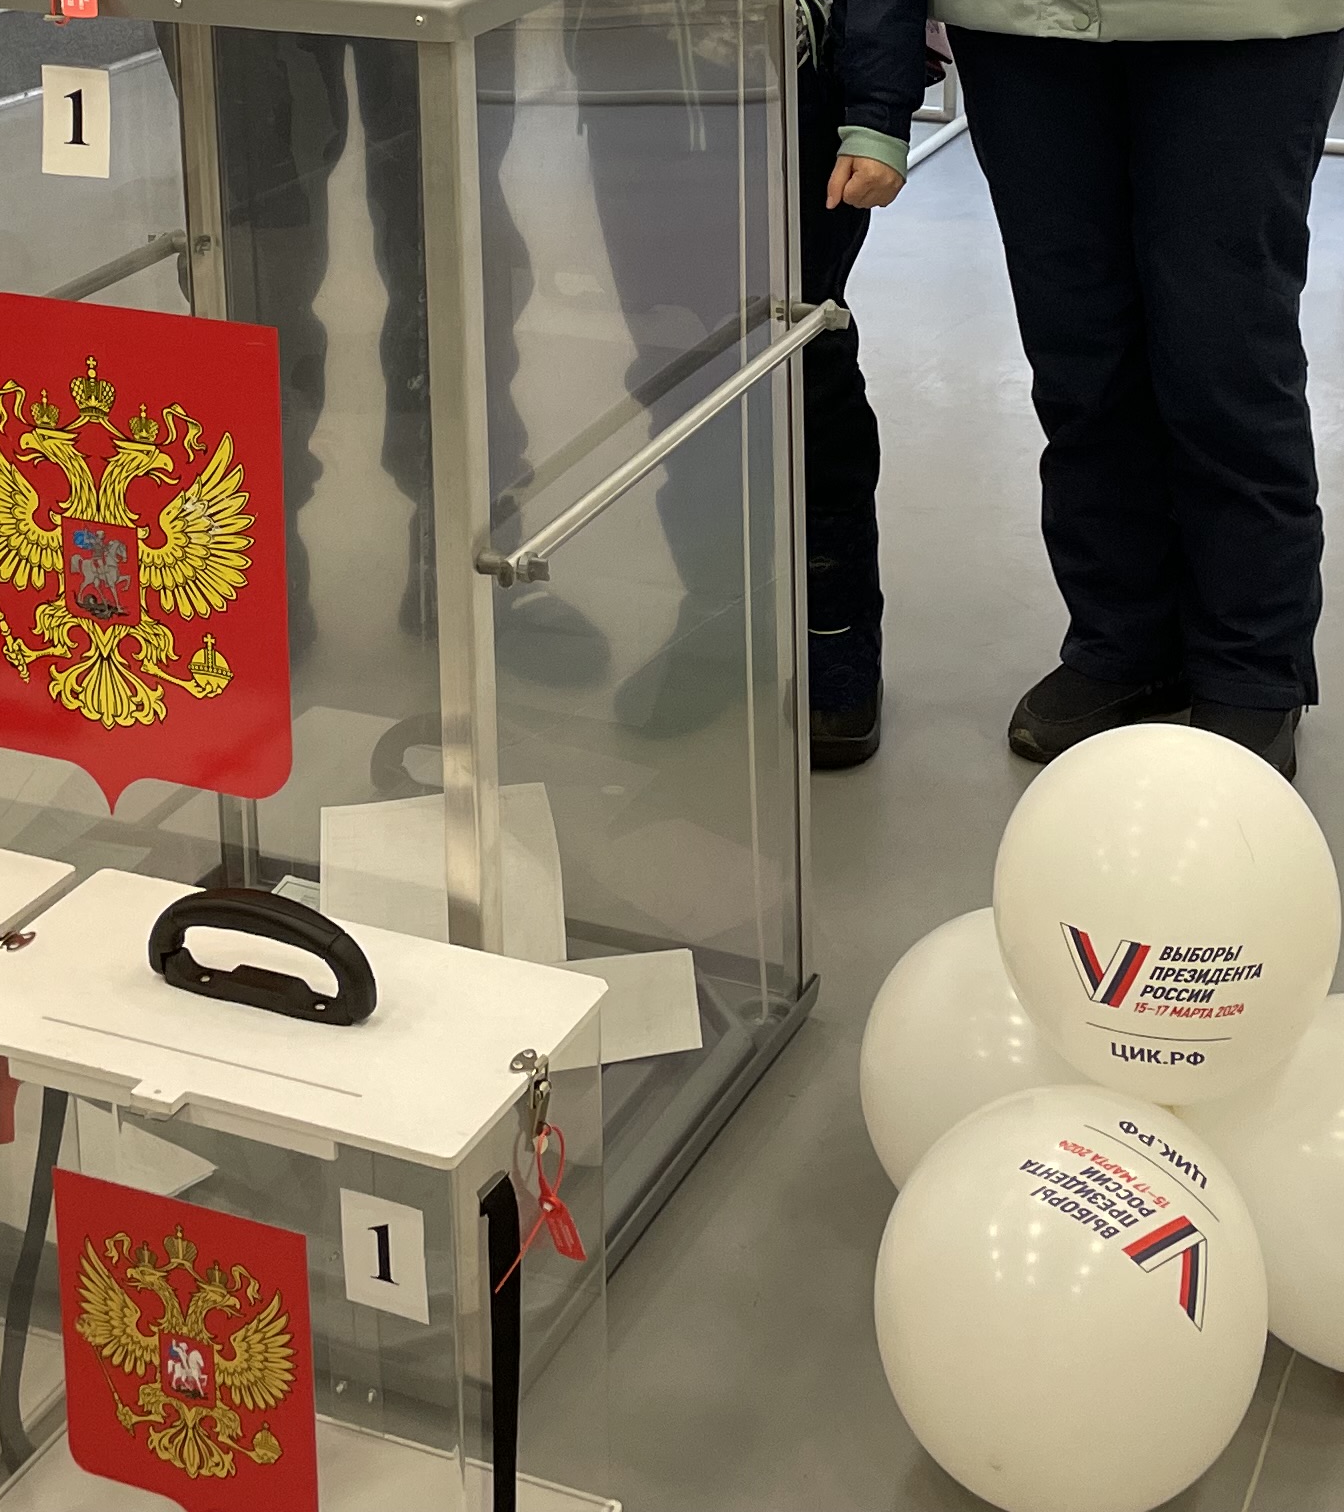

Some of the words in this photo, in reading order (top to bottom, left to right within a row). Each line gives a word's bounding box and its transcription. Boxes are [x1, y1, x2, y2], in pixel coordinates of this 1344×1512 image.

[63, 88, 90, 146] 1
[1159, 945, 1243, 963] ВЫБОРЫ
[1149, 963, 1264, 986] ПРЕЗИДЕНТА
[1140, 984, 1215, 1003] РОССИИ
[1169, 1006, 1214, 1019] МАРТА
[1214, 1003, 1245, 1019] 2024
[1110, 1041, 1206, 1066] ЦИК.РФ
[1058, 1139, 1094, 1158] 2024
[1118, 1120, 1208, 1190] ЦИК.РФ
[1090, 1153, 1138, 1183] МАРТА
[1019, 1159, 1139, 1228] ПРЕЗИДЕНТА
[1080, 1166, 1156, 1218] РОССИИ
[1030, 1185, 1120, 1239] ВЫБОРЫ
[367, 1224, 400, 1286] 1
